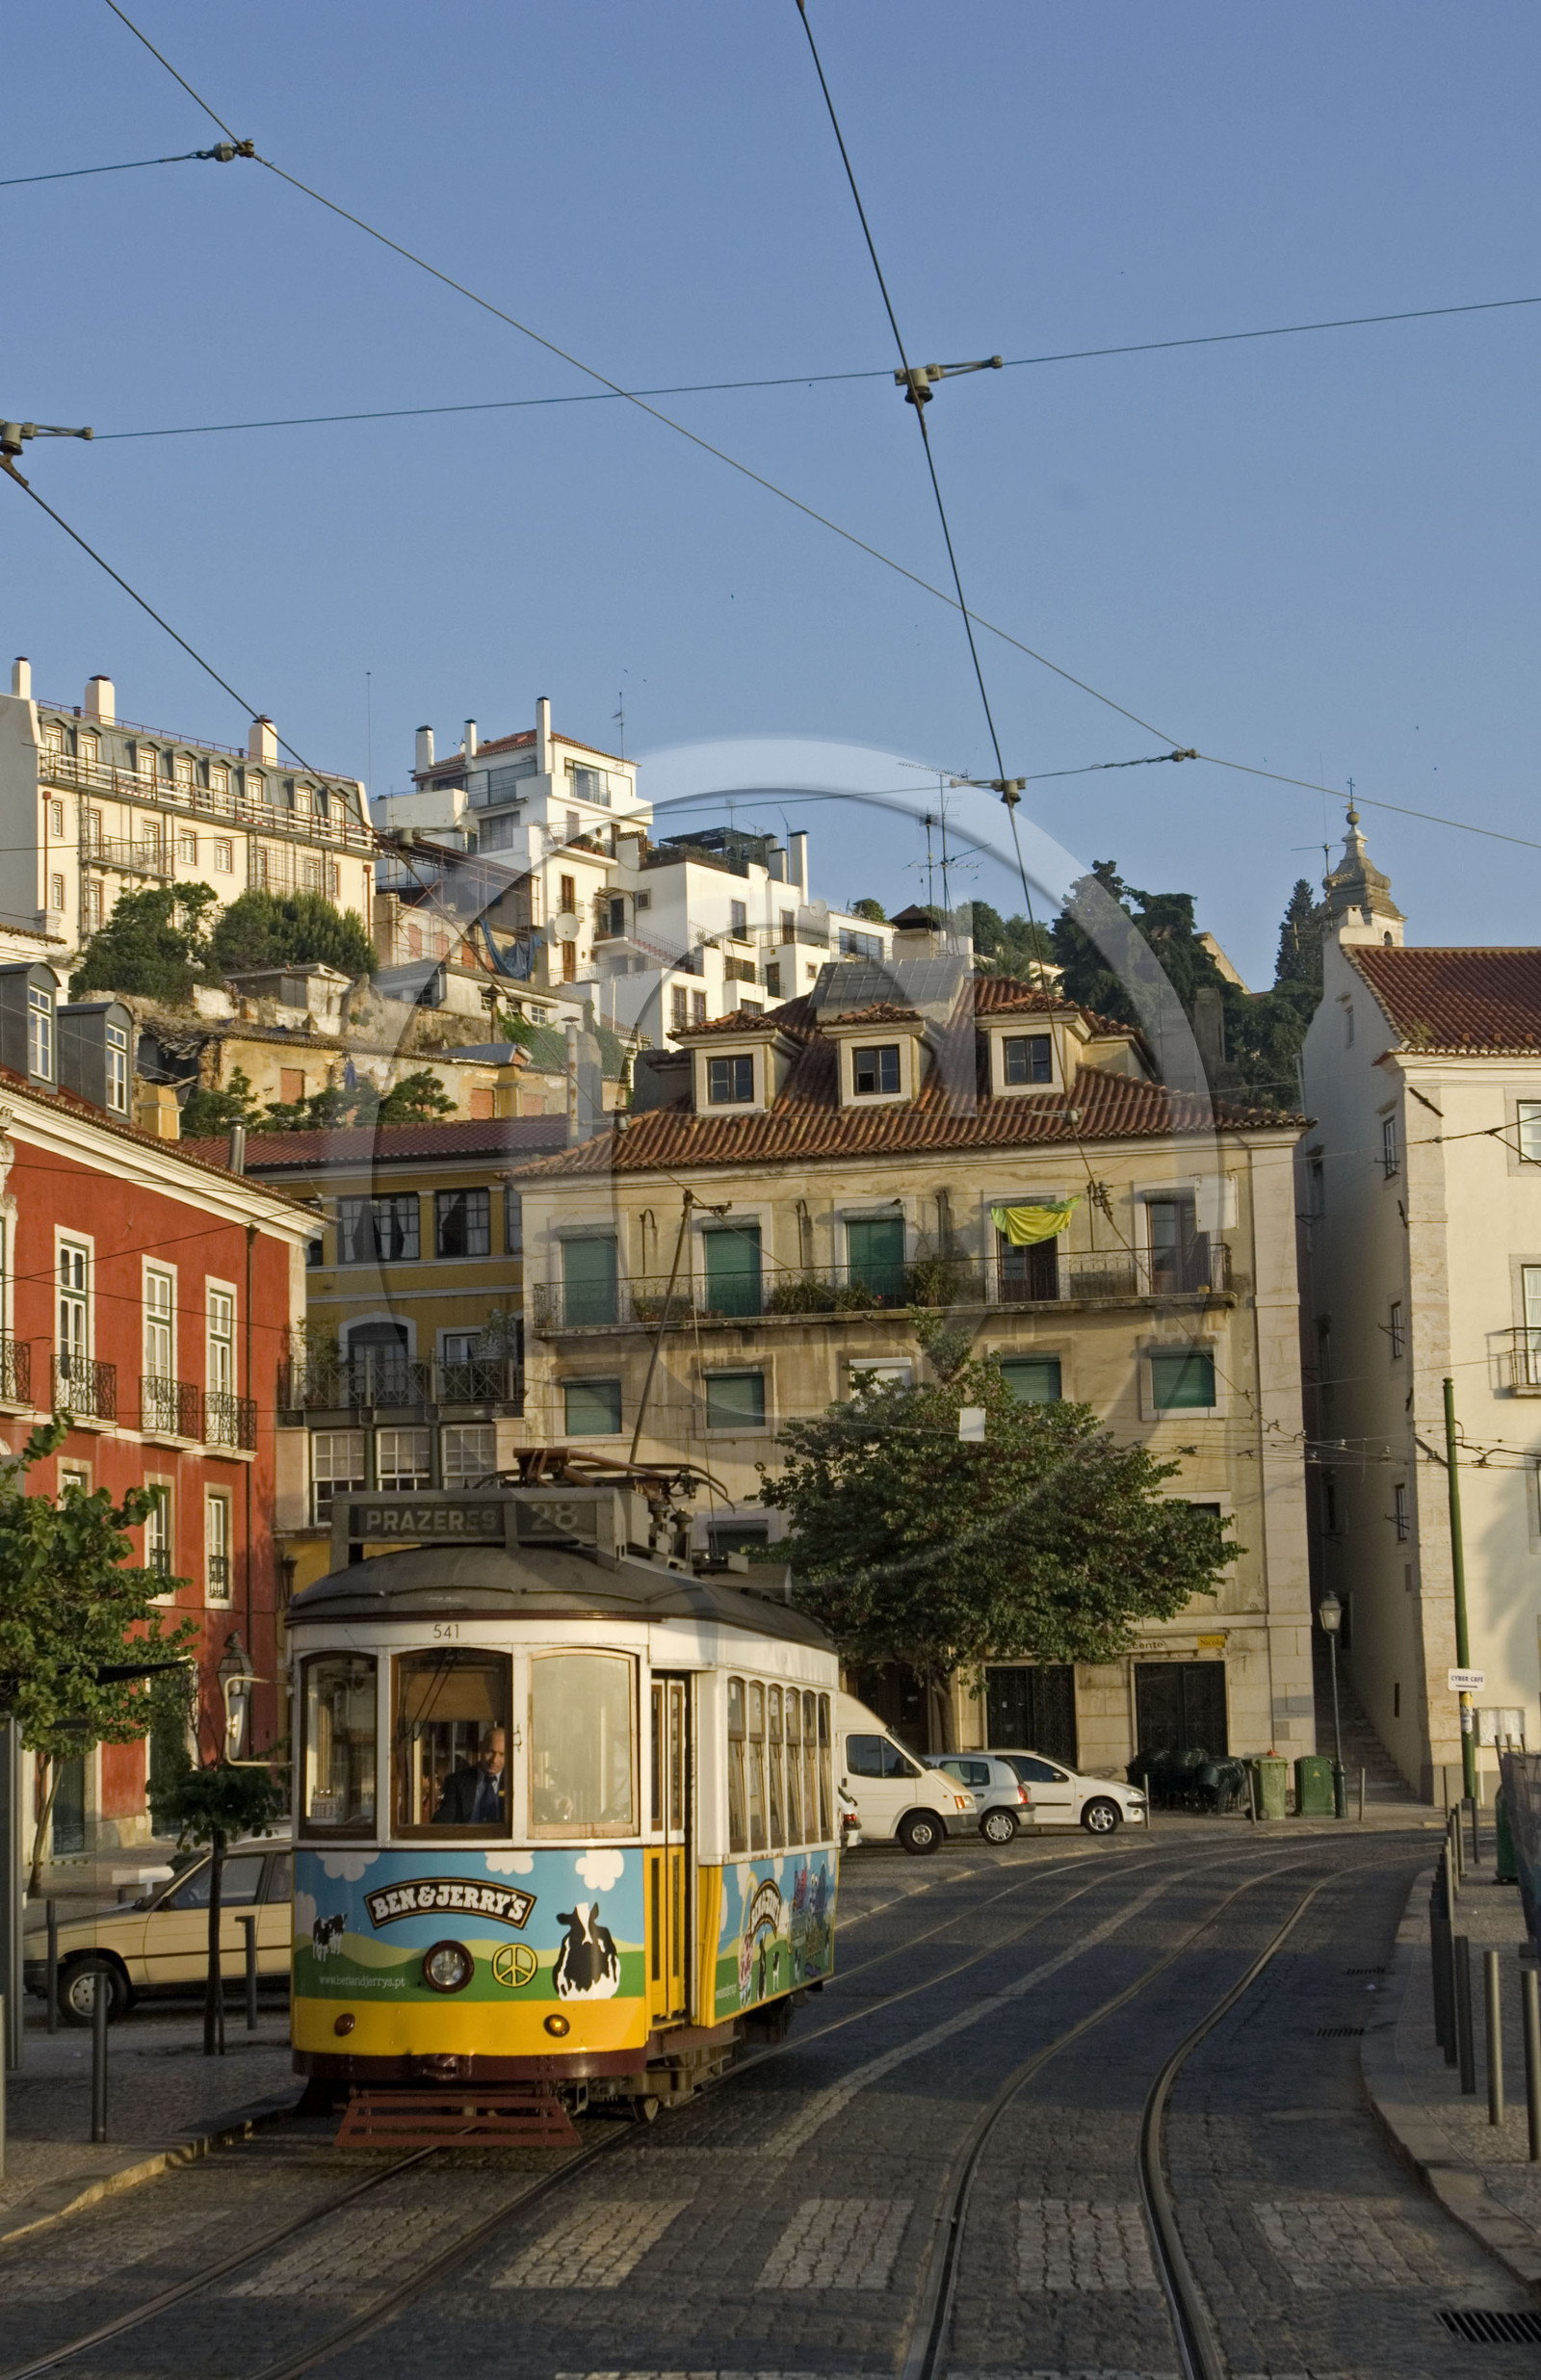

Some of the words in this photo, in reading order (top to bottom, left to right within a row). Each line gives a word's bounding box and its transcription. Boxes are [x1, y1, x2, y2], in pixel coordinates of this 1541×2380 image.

[366, 1509, 497, 1531] PRAZERES
[531, 1503, 579, 1531] 28
[433, 1625, 459, 1639] 541
[319, 1975, 405, 1989] www.benandjerrys.pt
